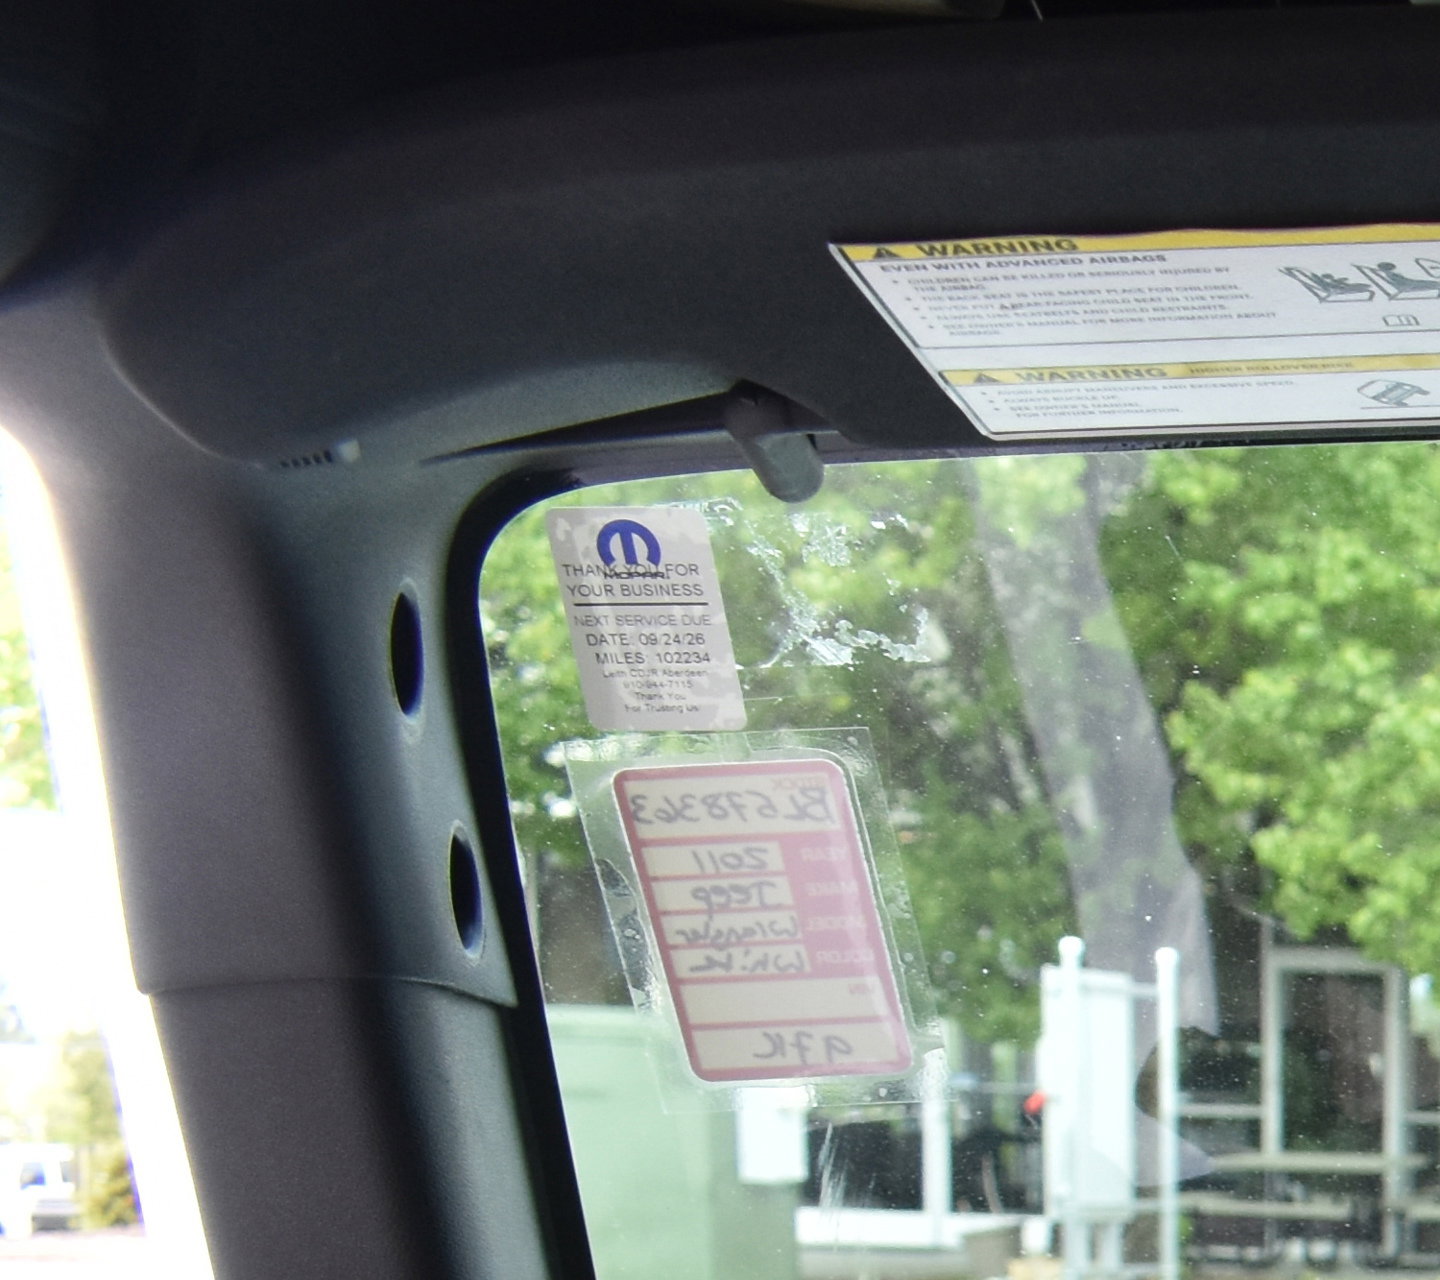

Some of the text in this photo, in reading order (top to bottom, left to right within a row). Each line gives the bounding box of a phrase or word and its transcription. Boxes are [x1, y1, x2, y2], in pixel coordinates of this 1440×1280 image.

[916, 239, 1078, 256] WARNING
[880, 254, 1167, 273] EVEN WITH ADVANCED AIRBAGS
[1015, 367, 1167, 382] WARNING
[562, 563, 699, 577] THANK YOU FOR
[567, 583, 704, 597] YOUR BUSINESS
[574, 614, 711, 627] NEXT SERVICE DUE
[656, 652, 710, 664] 102234
